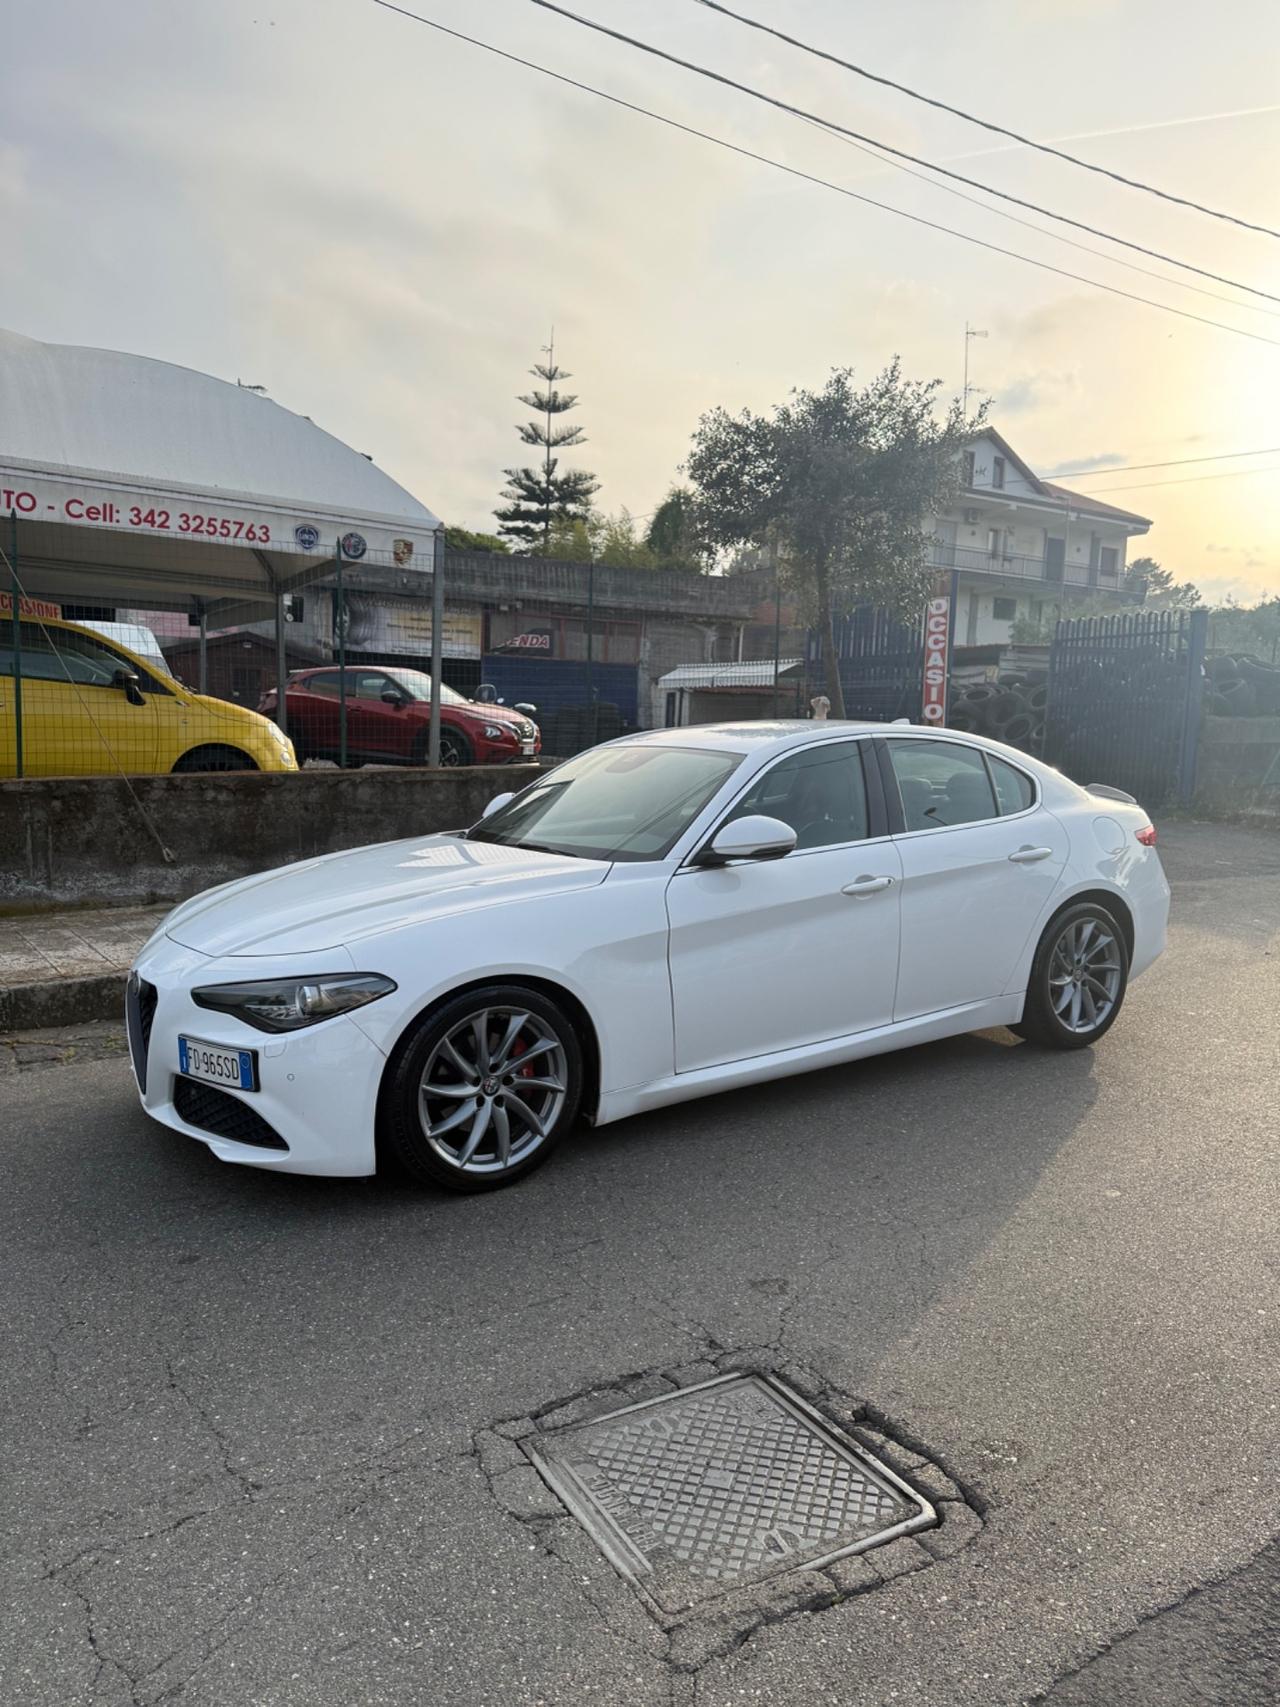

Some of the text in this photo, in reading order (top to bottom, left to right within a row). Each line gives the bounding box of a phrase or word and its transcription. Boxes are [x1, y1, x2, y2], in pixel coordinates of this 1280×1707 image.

[0, 489, 37, 512] TO
[65, 498, 120, 524] Cell:
[128, 506, 170, 529] 342
[178, 513, 270, 543] 3255763
